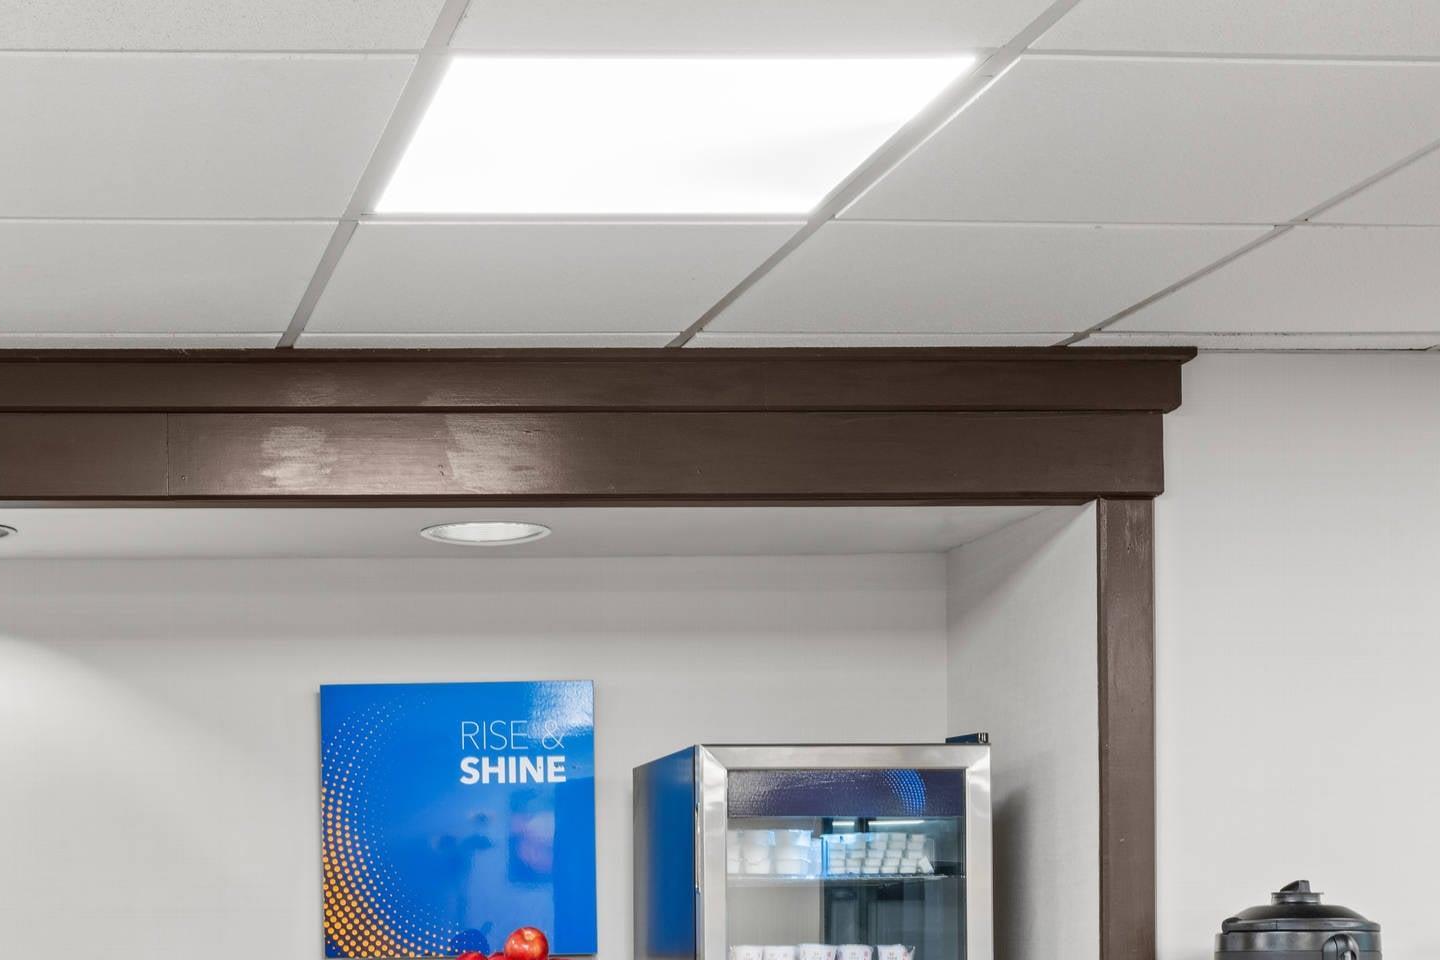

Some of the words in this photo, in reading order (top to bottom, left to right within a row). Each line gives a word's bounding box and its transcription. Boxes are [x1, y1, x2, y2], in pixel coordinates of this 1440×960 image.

[461, 719, 529, 751] RISE
[541, 719, 565, 750] &
[459, 756, 567, 785] SHINE
